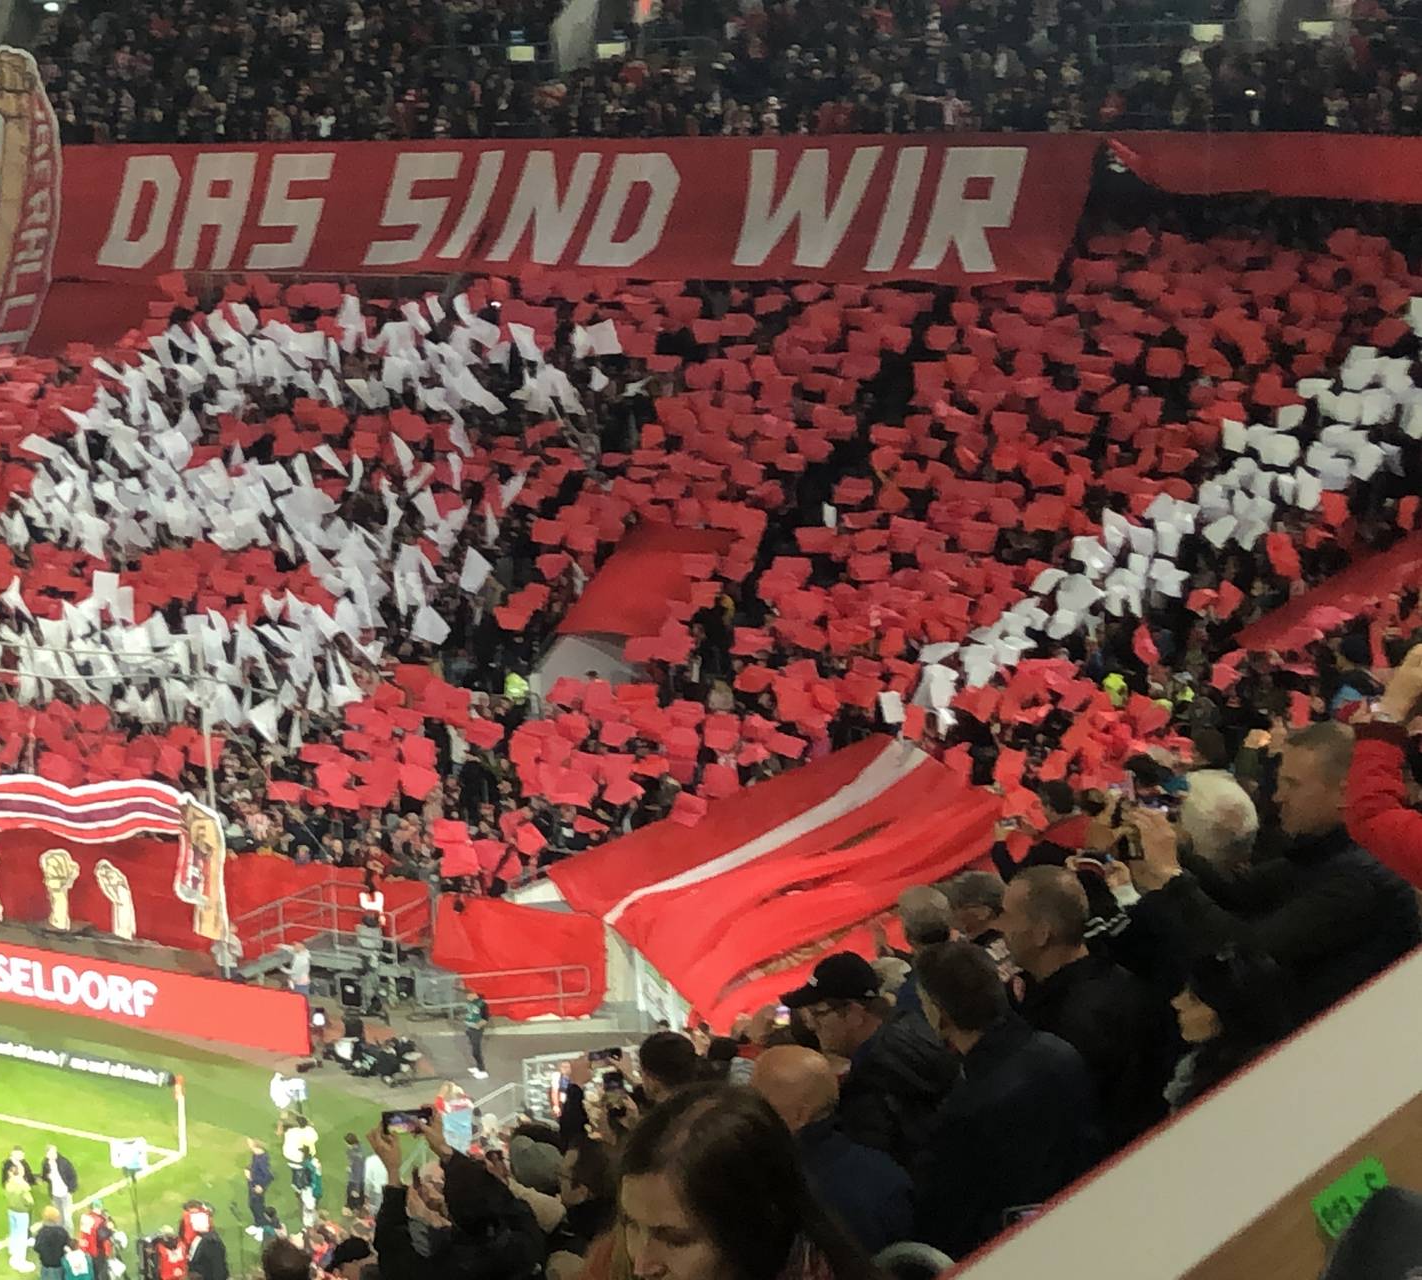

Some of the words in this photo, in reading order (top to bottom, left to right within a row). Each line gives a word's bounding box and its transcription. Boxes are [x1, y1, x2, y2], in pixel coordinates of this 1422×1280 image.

[97, 153, 336, 270] DAS
[364, 149, 681, 269] SIND
[732, 145, 1029, 273] WIR
